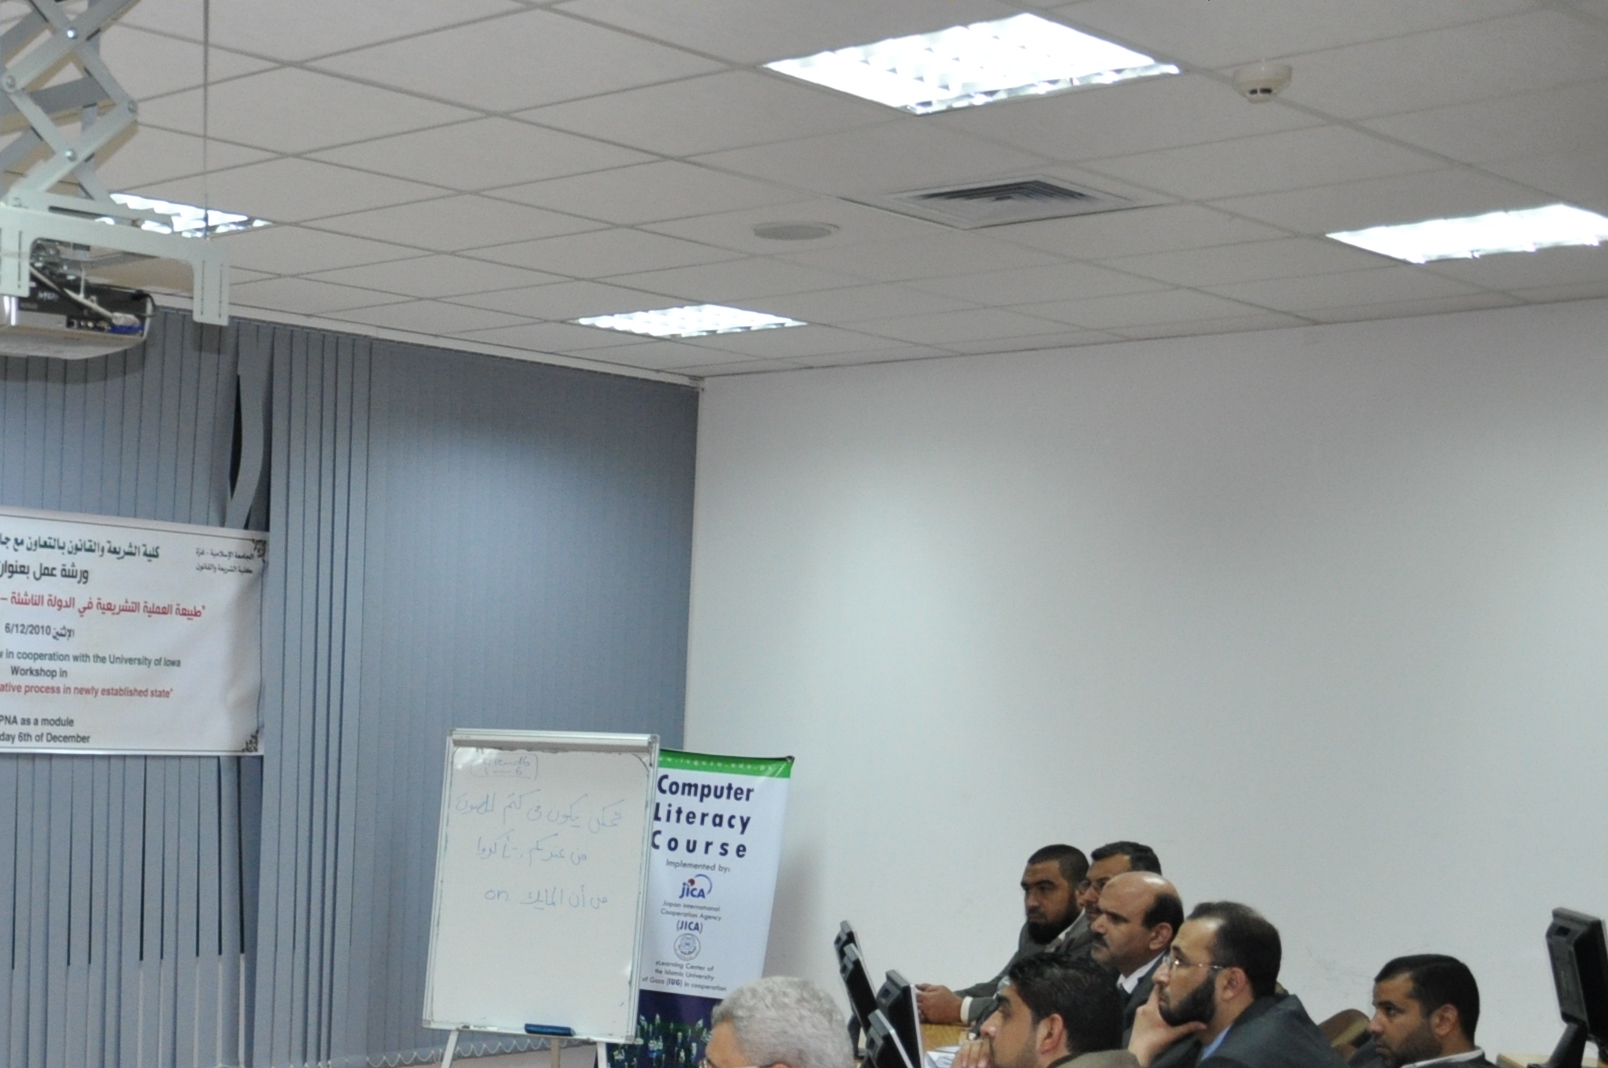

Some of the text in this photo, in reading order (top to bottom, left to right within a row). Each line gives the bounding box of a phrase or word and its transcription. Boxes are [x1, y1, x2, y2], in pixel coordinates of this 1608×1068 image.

[13, 537, 24, 552] مع
[26, 535, 65, 556] بالتعاون
[67, 537, 105, 557] والقانون
[106, 541, 141, 560] الشريعة
[142, 543, 160, 562] كلية
[32, 562, 57, 581] عمل
[60, 562, 89, 584] ورشة
[10, 590, 44, 606] الناشئة
[47, 594, 75, 609] الدولة
[96, 597, 140, 615] التشريعية
[78, 597, 93, 617] في
[142, 600, 173, 617] العملية
[4, 622, 51, 636] 6/12/2010
[5, 649, 14, 659] in
[16, 650, 70, 662] cooperation
[72, 652, 91, 663] with
[92, 653, 107, 664] the
[109, 654, 152, 668] University
[154, 656, 163, 666] of
[163, 657, 181, 668] Iowa
[10, 665, 68, 679] Workshop in
[23, 684, 61, 695] process
[63, 684, 72, 694] in
[73, 685, 99, 697] newly
[100, 686, 149, 698] established
[20, 717, 31, 726] as
[33, 717, 39, 726] a
[40, 716, 75, 727] module
[17, 731, 33, 742] 6th
[34, 732, 44, 742] of
[45, 732, 91, 743] December
[657, 774, 754, 803] Computer
[653, 802, 751, 835] Literacy
[651, 830, 747, 858] Course
[666, 859, 716, 872] Implemented
[484, 890, 509, 901] on
[662, 900, 720, 912] Japan International
[660, 908, 722, 922] Cooperation Agency
[676, 920, 704, 934] (JICA)
[664, 969, 684, 977] Islamic
[685, 972, 714, 981] University
[685, 963, 706, 971] Center
[649, 976, 665, 985] Gaza
[691, 983, 727, 992] cooperation
